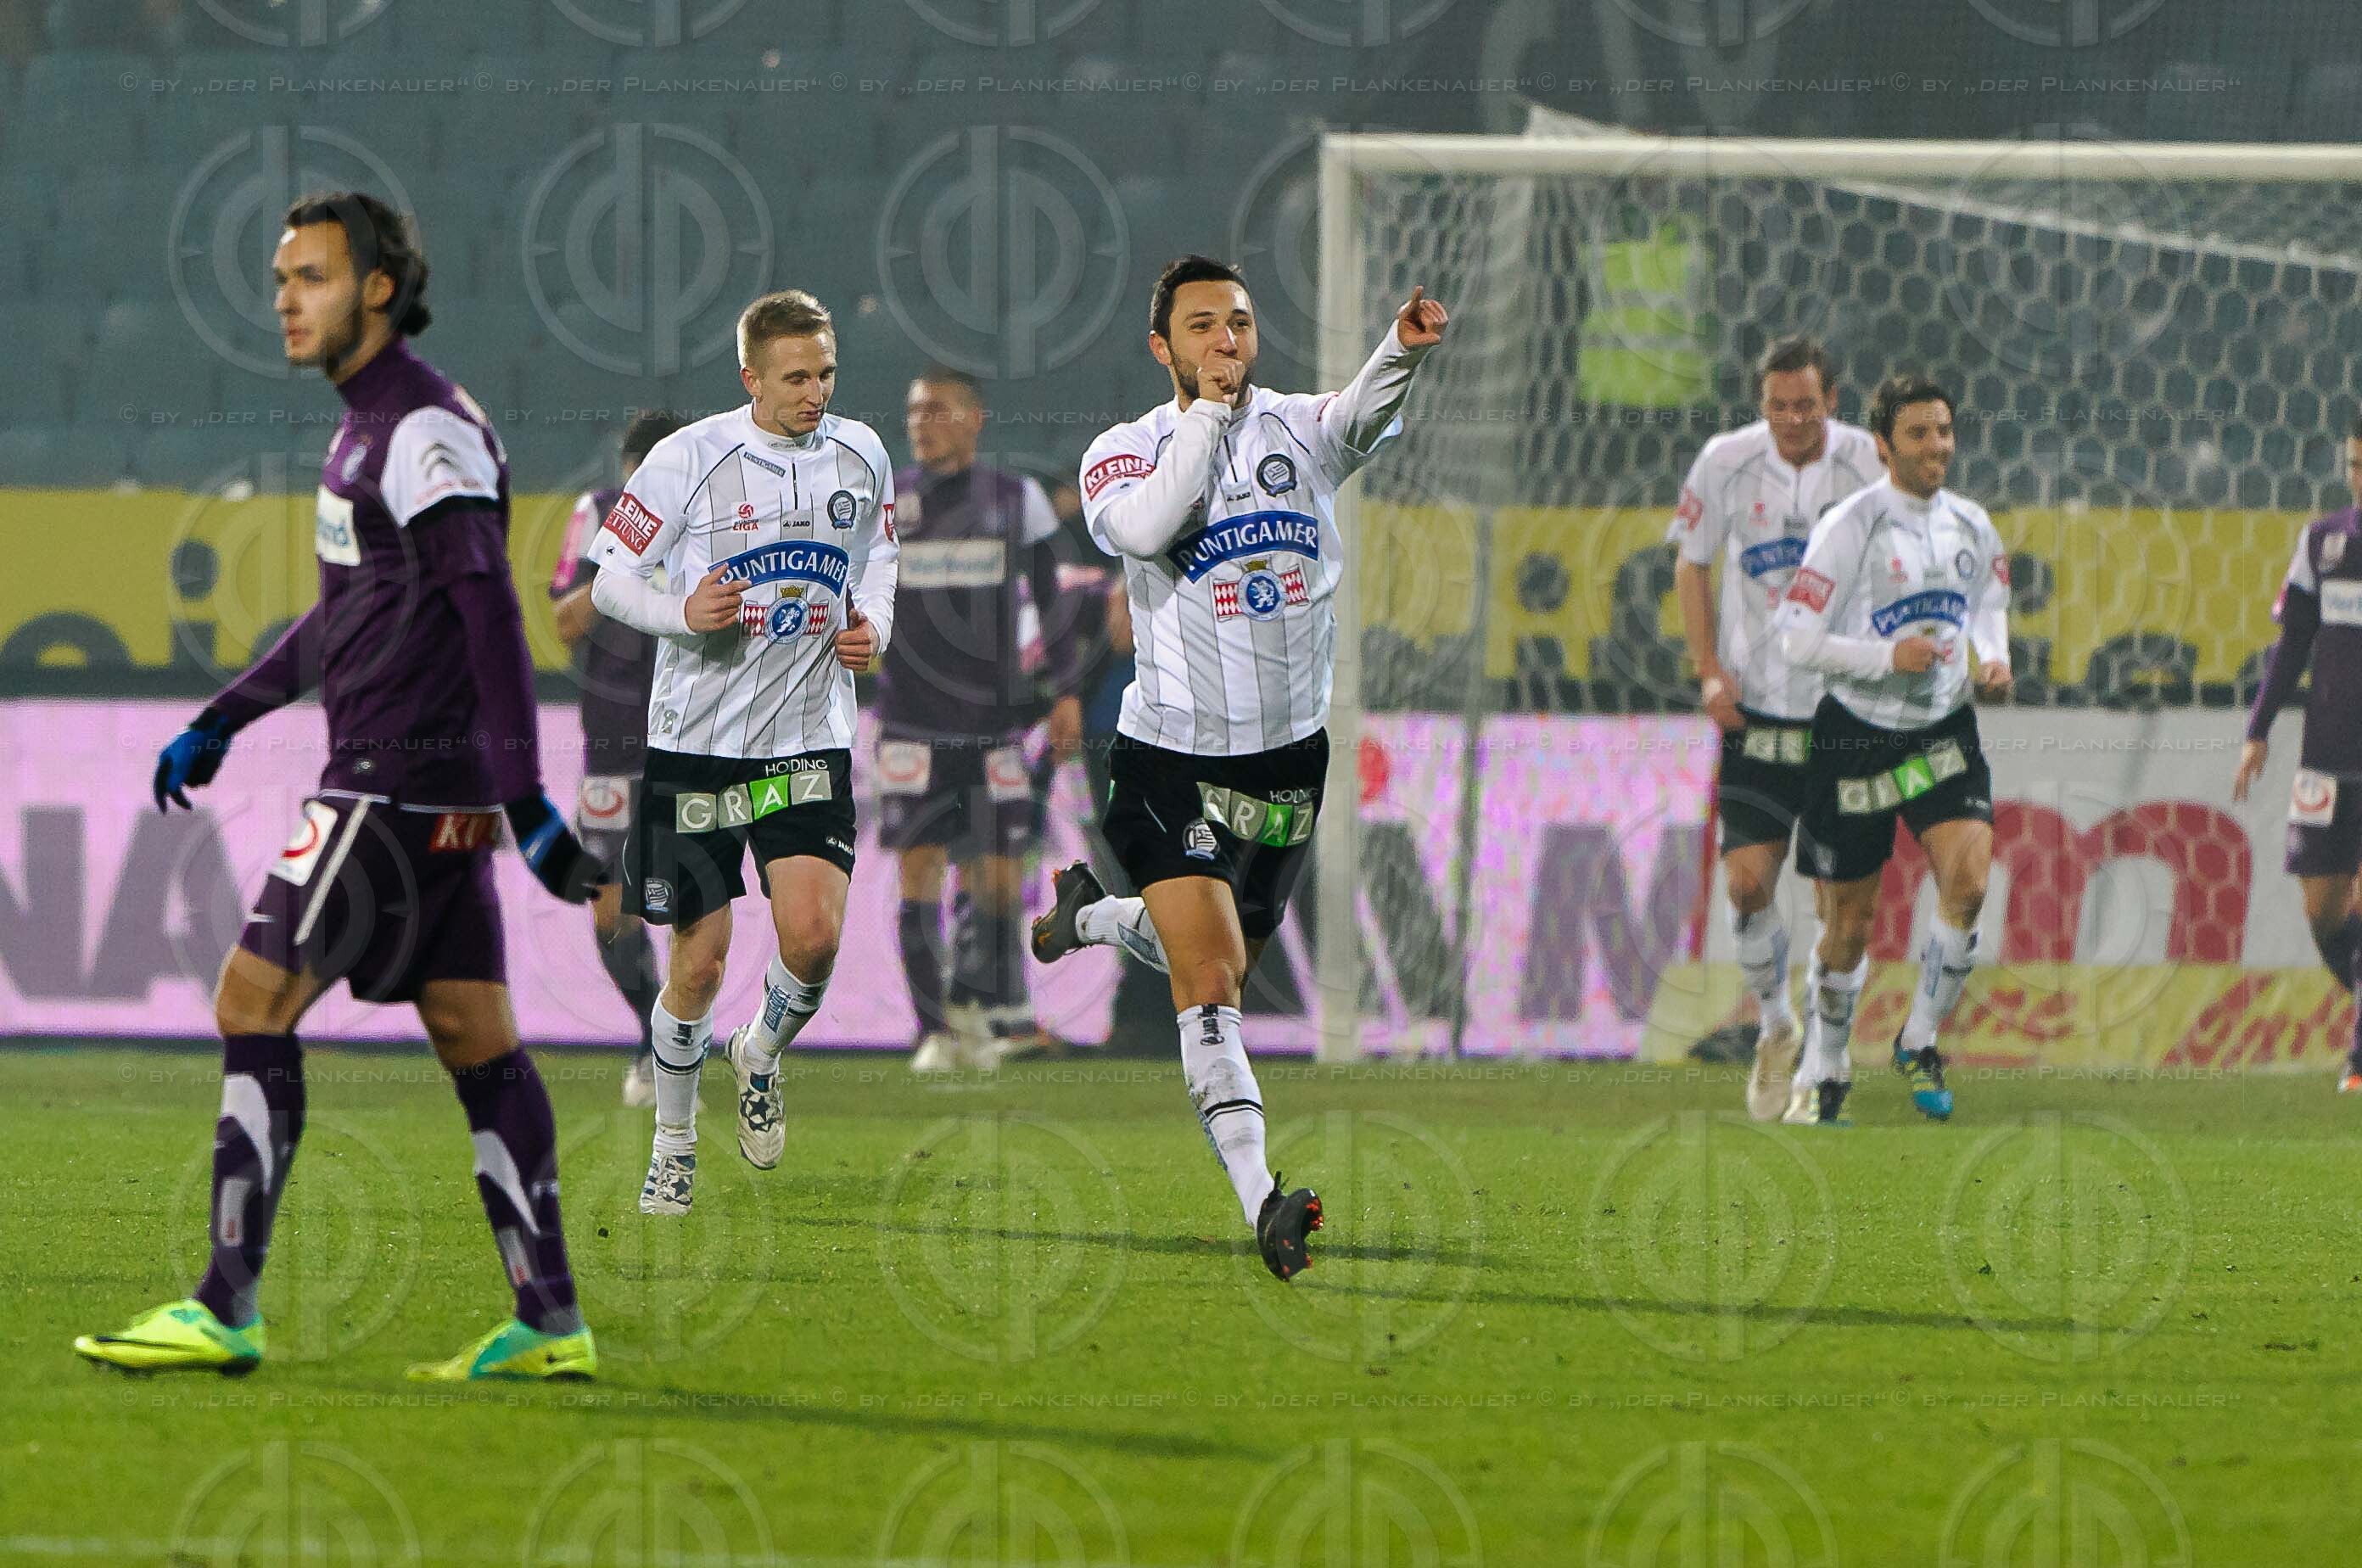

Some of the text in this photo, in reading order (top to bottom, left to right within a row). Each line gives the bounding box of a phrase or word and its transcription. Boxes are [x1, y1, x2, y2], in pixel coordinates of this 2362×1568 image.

[613, 495, 658, 538] LEINE
[765, 758, 827, 777] HODING
[681, 774, 823, 830] GRAZ
